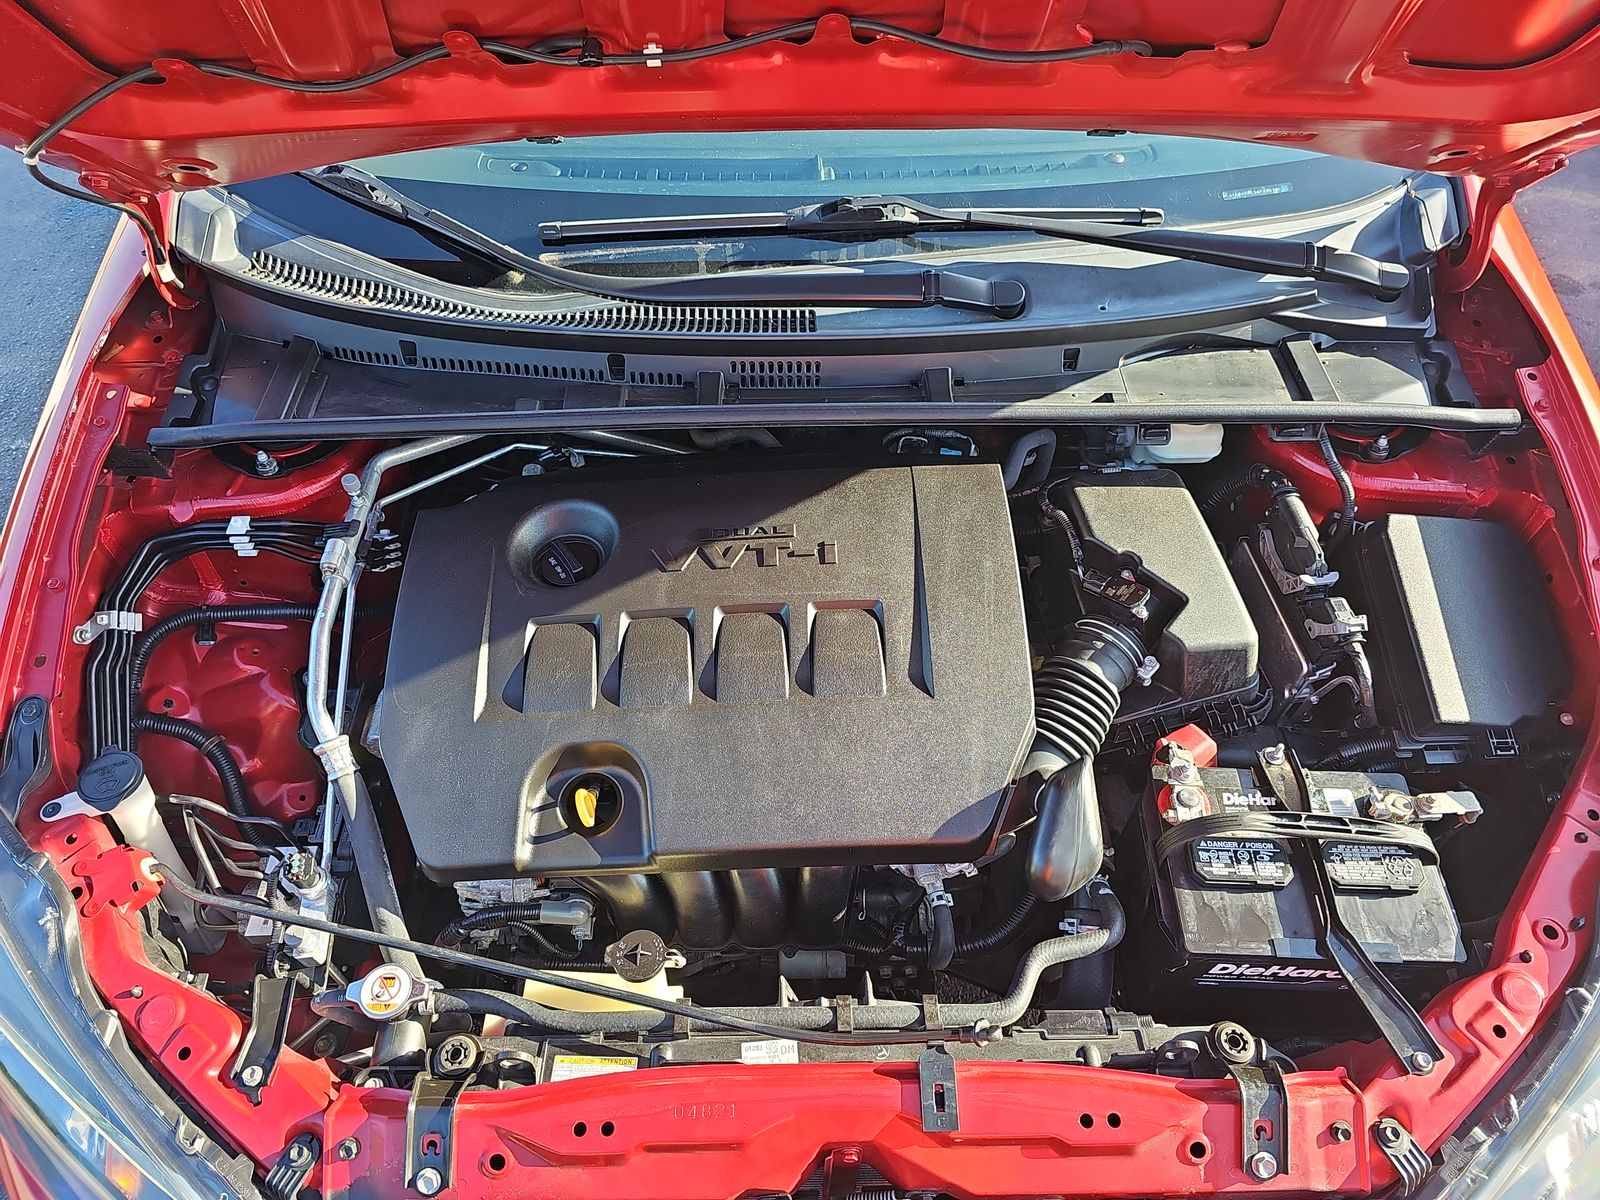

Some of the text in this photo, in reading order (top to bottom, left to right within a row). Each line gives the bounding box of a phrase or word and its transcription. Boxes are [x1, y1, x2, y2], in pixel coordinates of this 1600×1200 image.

[711, 525, 788, 538] DUAL
[1222, 792, 1277, 806] DieHar
[673, 1103, 737, 1120] 04821
